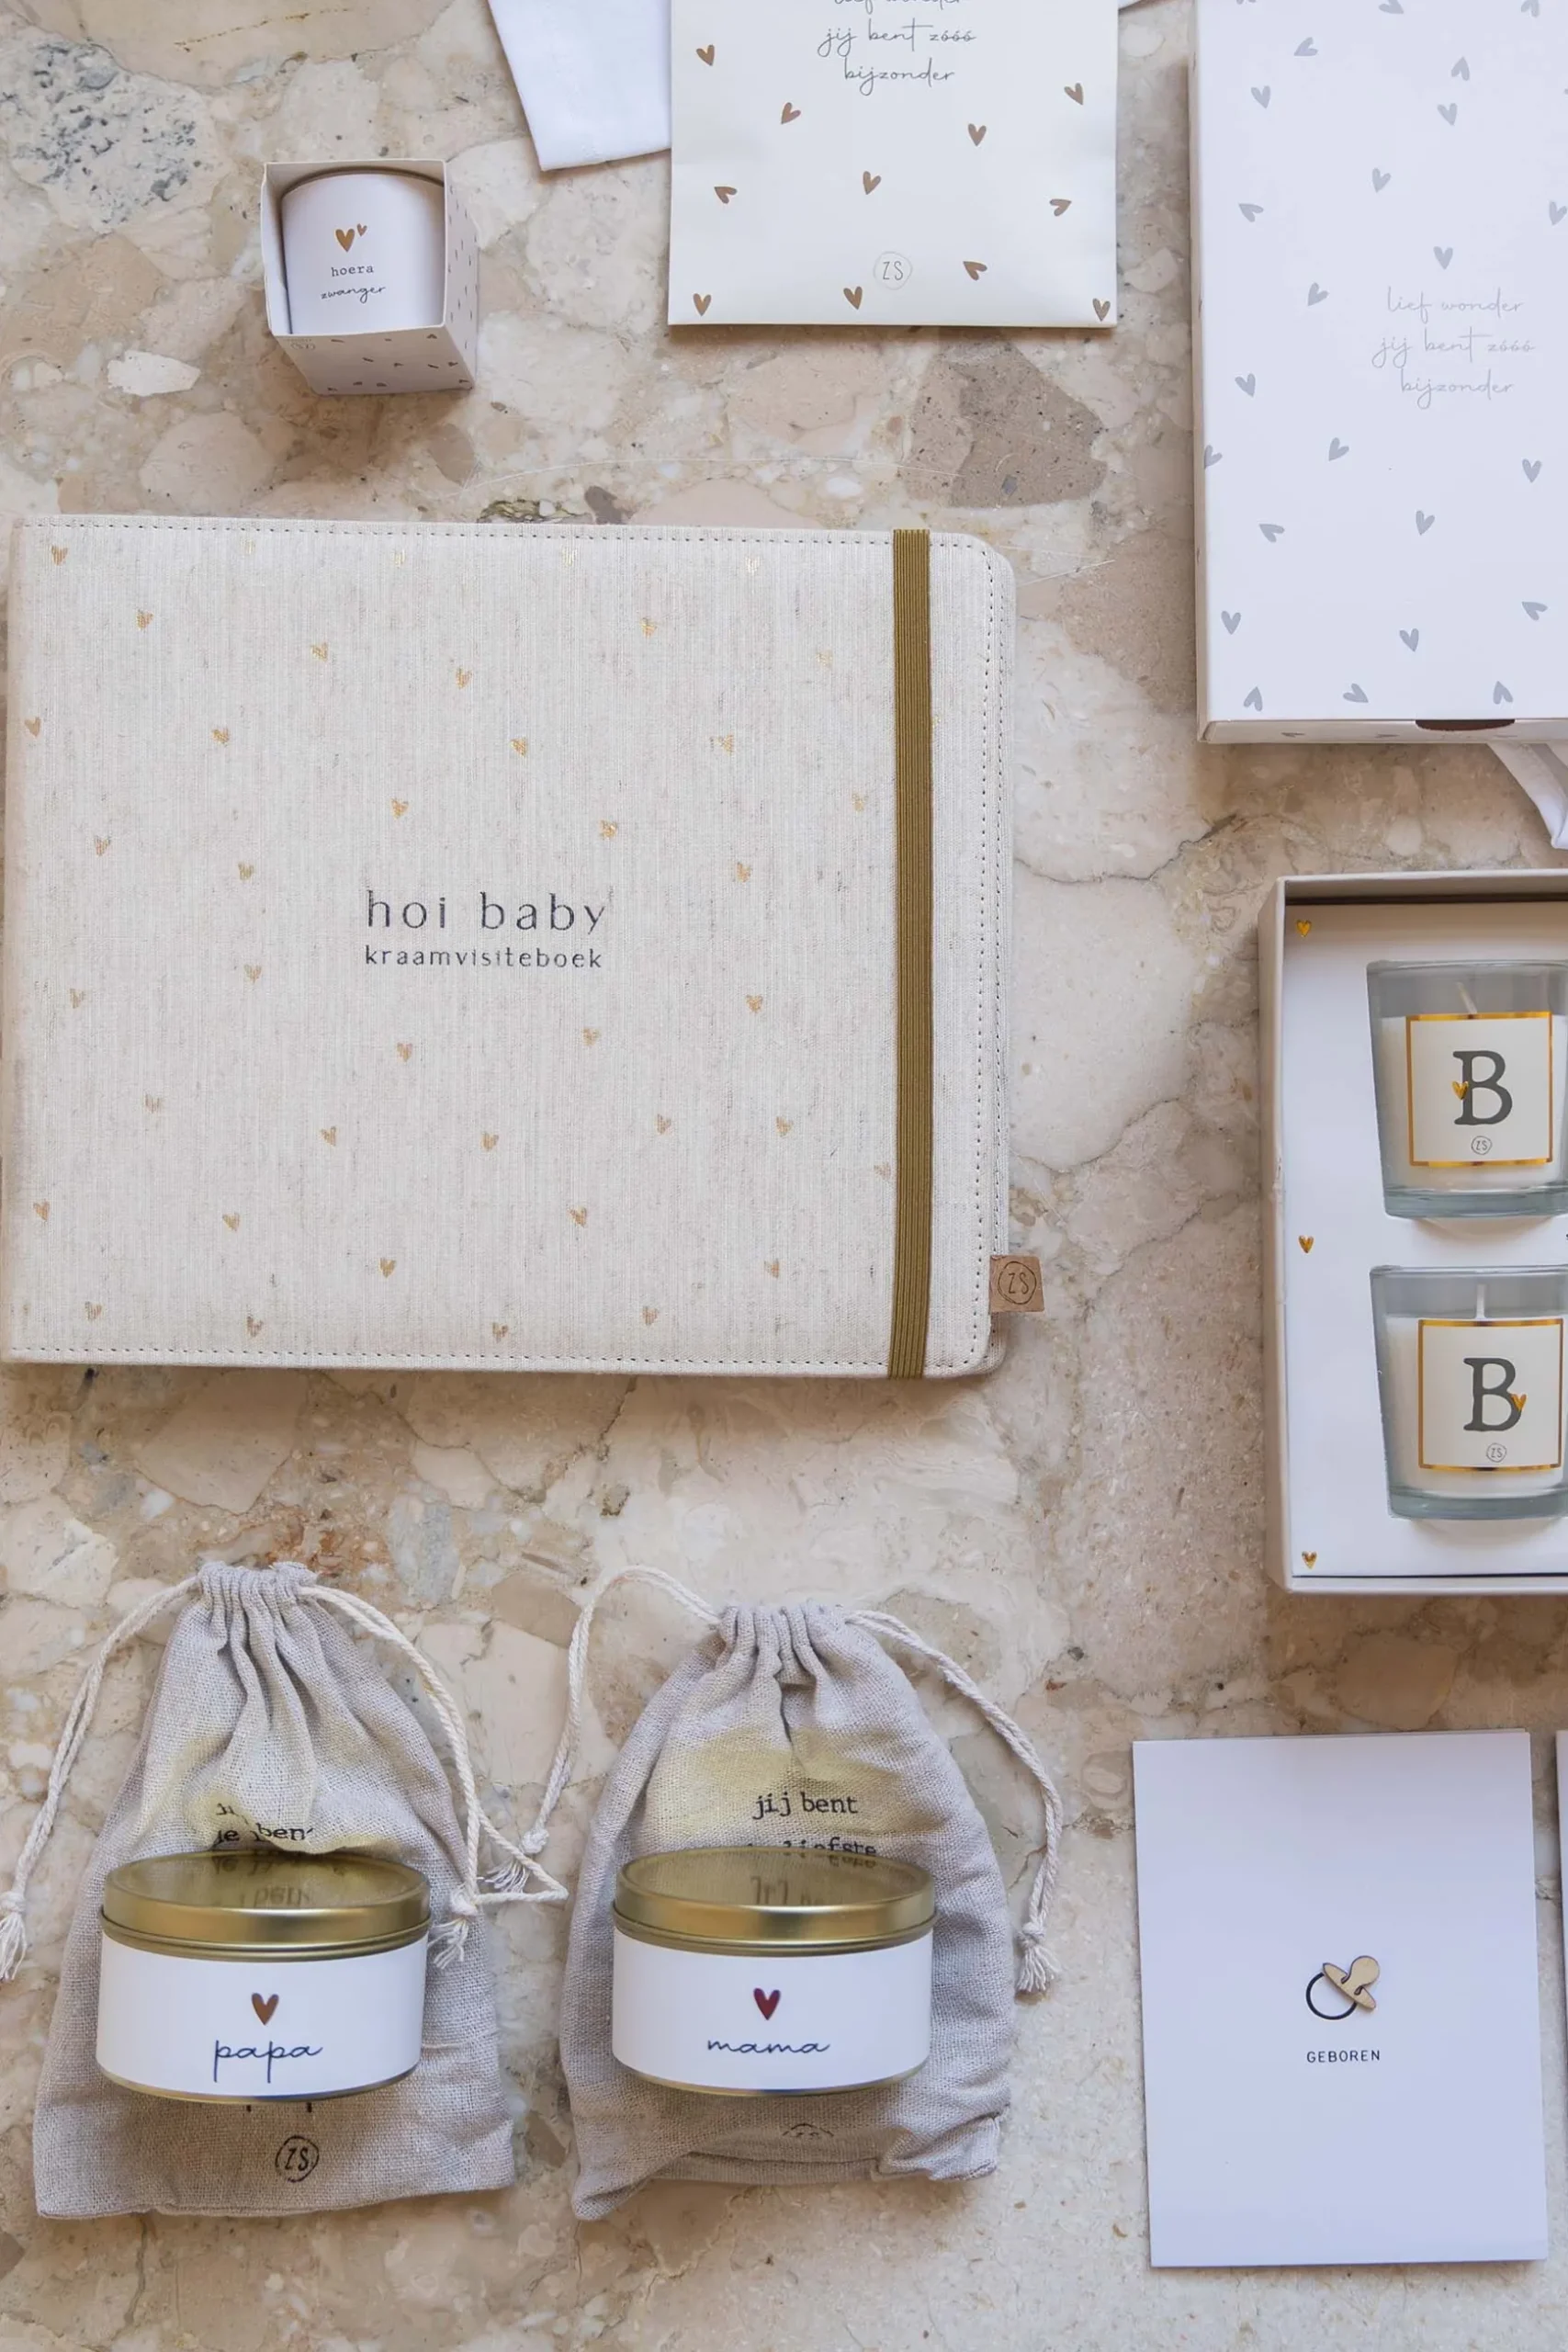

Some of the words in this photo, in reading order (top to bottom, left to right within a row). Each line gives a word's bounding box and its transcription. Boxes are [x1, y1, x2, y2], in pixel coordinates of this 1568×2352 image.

[817, 28, 858, 58] jij
[868, 17, 934, 52] bent
[844, 57, 955, 96] bijzonder
[331, 264, 375, 277] hoera
[320, 285, 387, 304] zwanger
[1387, 286, 1433, 324] lief
[1440, 287, 1525, 319] wonder
[1371, 336, 1414, 369] jij
[1424, 325, 1494, 364] bent
[1400, 367, 1515, 410] bijzonder
[367, 889, 446, 930] hoi
[479, 890, 606, 935] baby
[366, 944, 603, 968] kraamvisiteboek
[1452, 1049, 1513, 1126] B
[1462, 1357, 1523, 1432] B
[752, 1791, 792, 1820] jij
[800, 1791, 859, 1814] bent
[213, 2040, 323, 2084] papa
[706, 2040, 831, 2054] mama
[1305, 2049, 1381, 2064] GEBOREN
